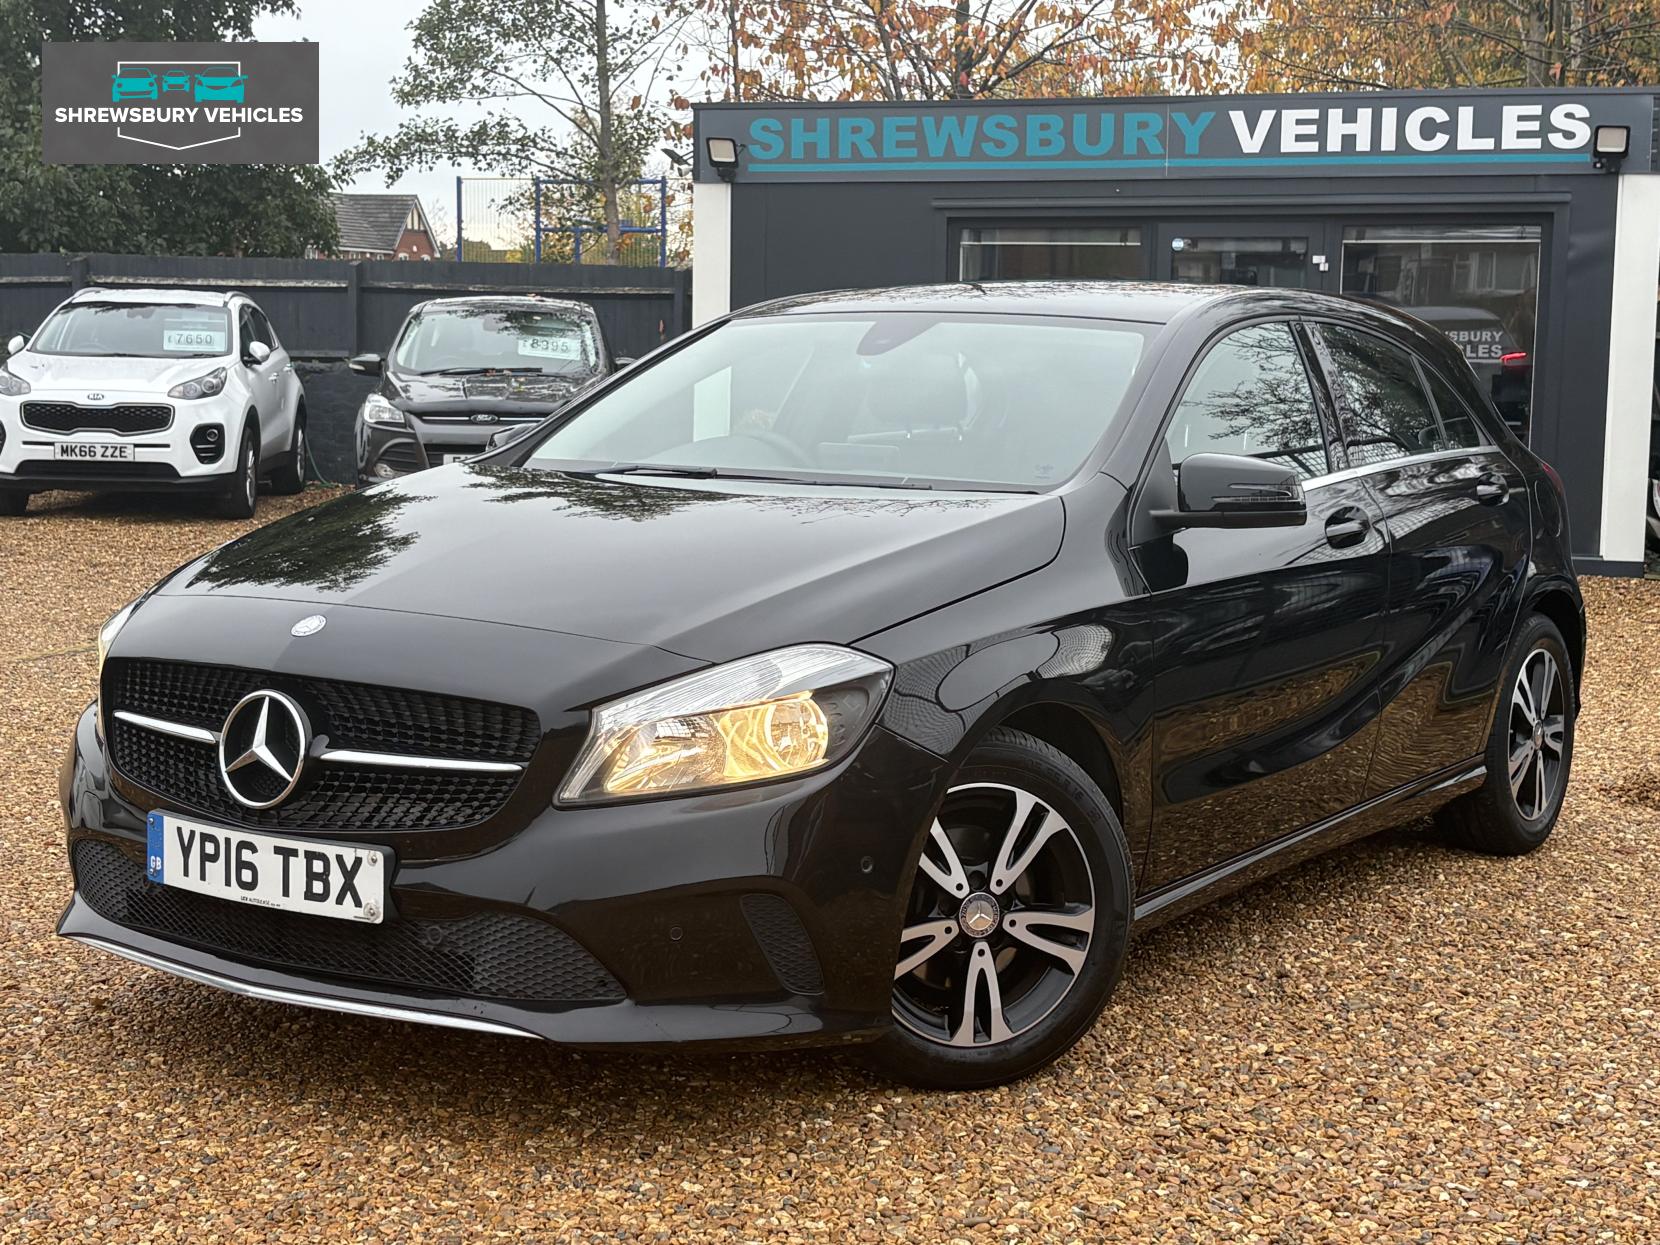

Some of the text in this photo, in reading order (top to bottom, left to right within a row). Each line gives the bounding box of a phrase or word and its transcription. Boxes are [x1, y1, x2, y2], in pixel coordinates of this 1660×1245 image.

[748, 103, 1591, 160] SHREWSBURY VEHICLES
[1445, 330, 1504, 342] SBURY
[60, 444, 128, 459] MK66 ZZE
[150, 855, 162, 871] GB
[176, 825, 363, 909] YP16 TBX
